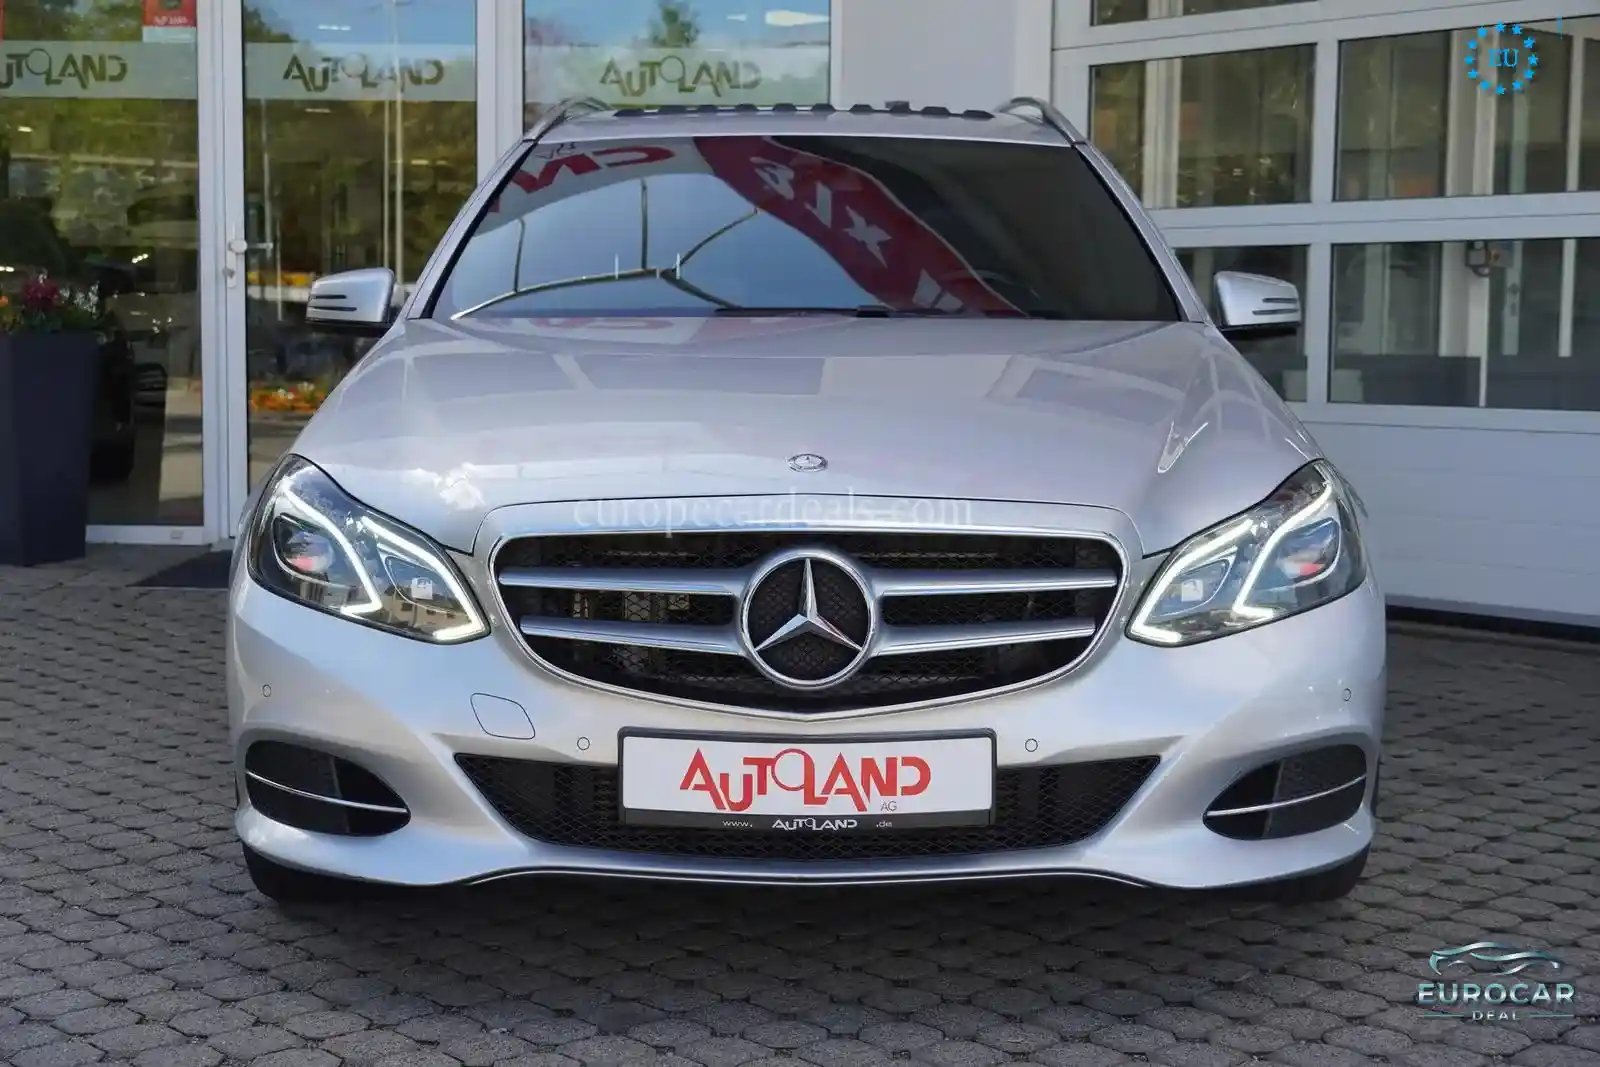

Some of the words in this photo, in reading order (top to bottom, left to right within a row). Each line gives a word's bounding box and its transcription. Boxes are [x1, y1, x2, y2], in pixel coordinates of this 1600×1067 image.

[283, 53, 444, 92] AUTOLAND
[600, 55, 762, 97] AUTOLAND
[680, 747, 931, 812] AUTOLAND
[722, 820, 753, 828] www.
[772, 817, 858, 831] AUTOLAND
[881, 801, 898, 812] AG
